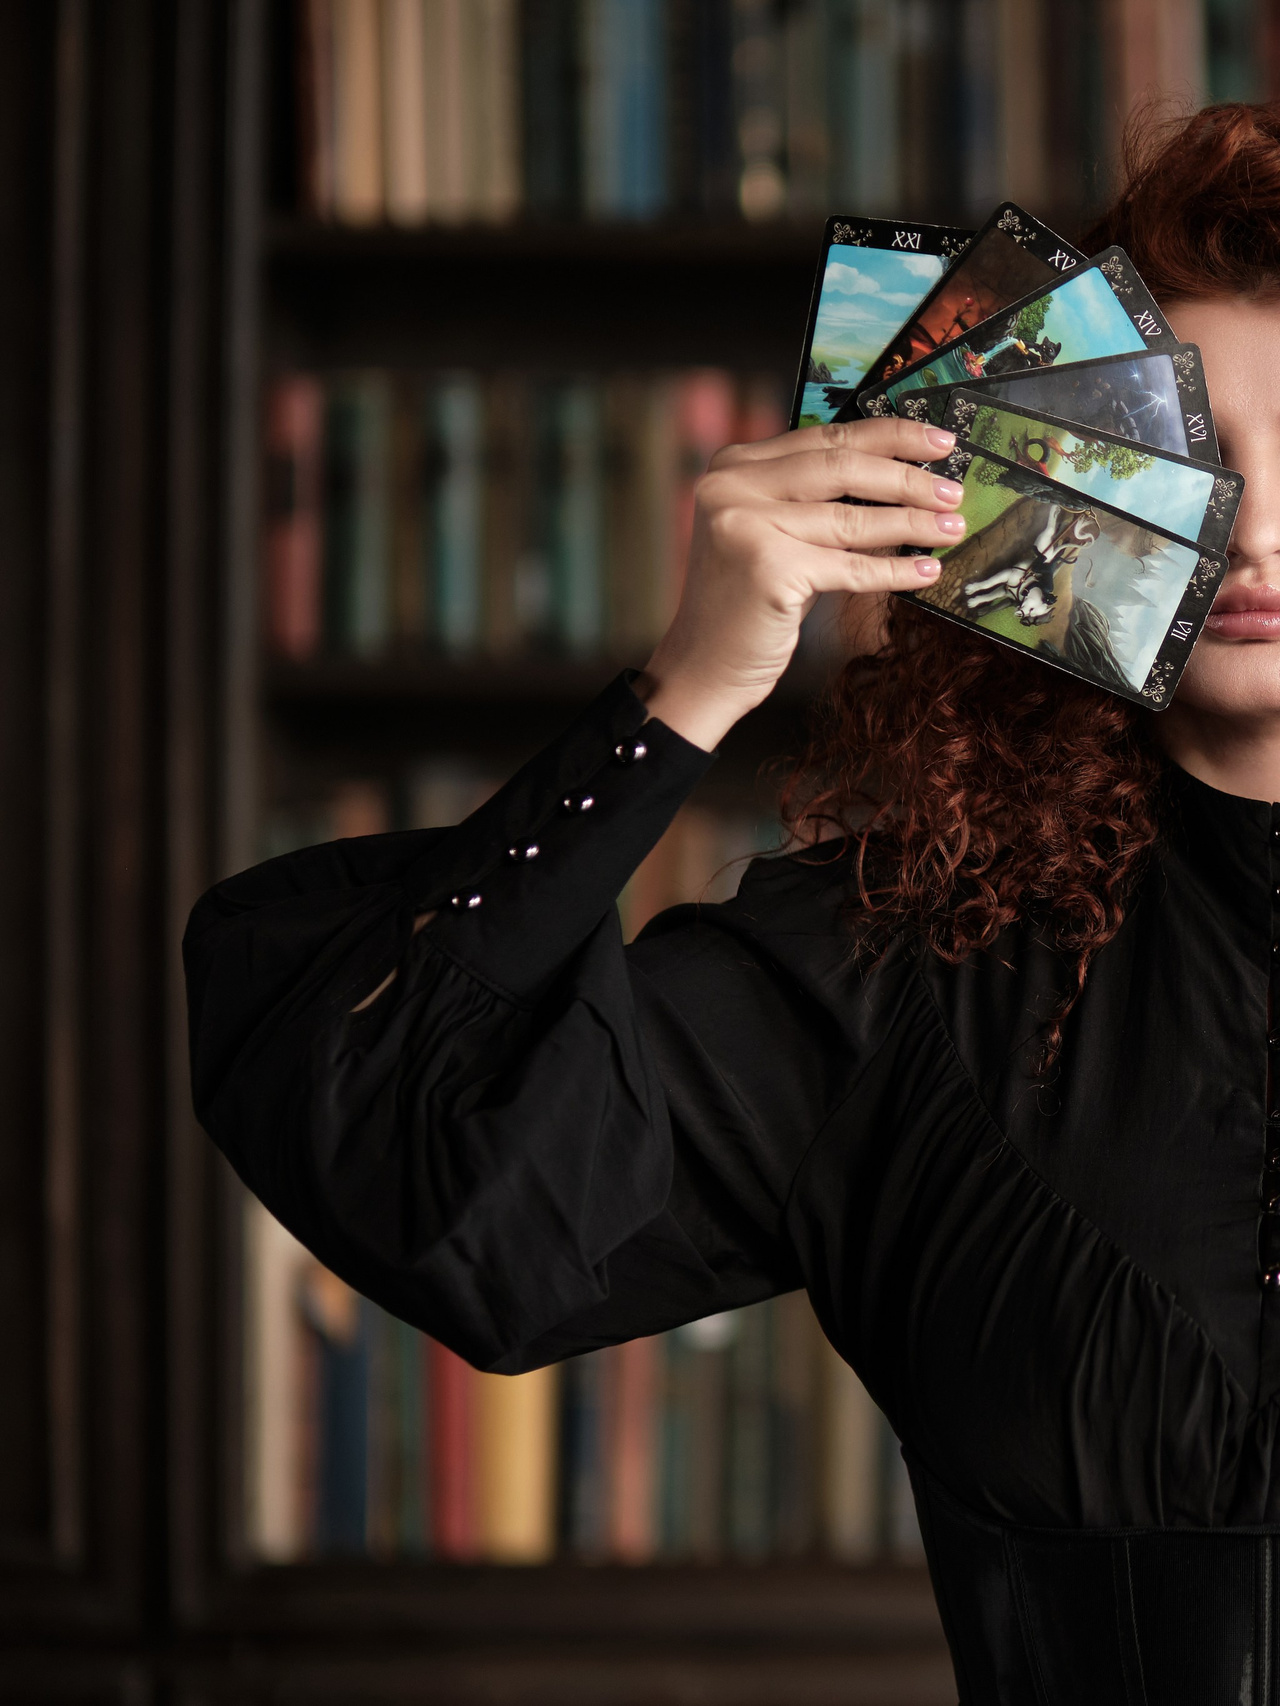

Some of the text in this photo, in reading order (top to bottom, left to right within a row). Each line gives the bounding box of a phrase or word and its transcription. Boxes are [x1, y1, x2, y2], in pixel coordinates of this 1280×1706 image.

[891, 231, 921, 249] XXI
[1047, 248, 1077, 271] XV
[1133, 309, 1162, 337] XIV
[1185, 413, 1208, 443] XVI
[1170, 619, 1194, 642] VII
